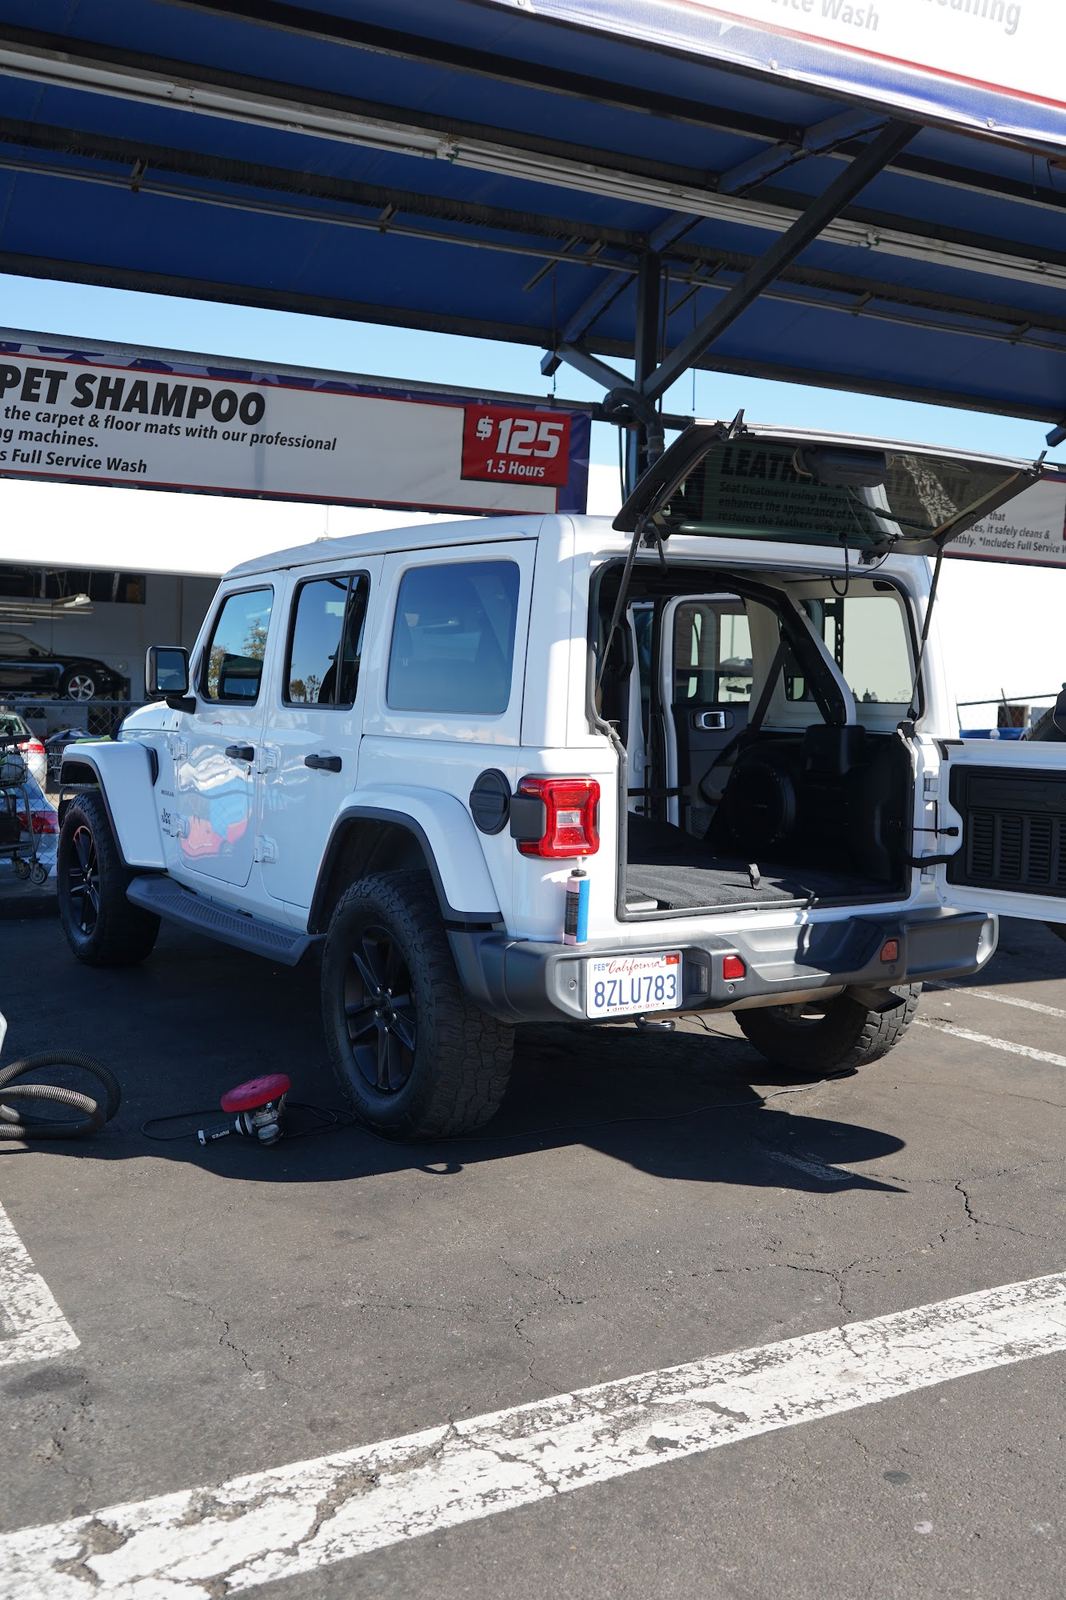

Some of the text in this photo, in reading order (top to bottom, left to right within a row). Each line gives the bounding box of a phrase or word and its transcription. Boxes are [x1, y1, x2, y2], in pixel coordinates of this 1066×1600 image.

[821, 0, 880, 31] Wash
[0, 363, 266, 426] PET SHAMPOO
[4, 405, 337, 451] the carpet & floor mats with our professional
[18, 428, 99, 448] machines.
[475, 416, 564, 459] $125
[11, 448, 42, 465] Full
[46, 451, 102, 470] Service
[106, 456, 148, 474] Wash
[486, 459, 546, 477] 1.5 Hours
[720, 446, 829, 487] LEATH
[989, 511, 1006, 522] that
[986, 523, 994, 533] it
[994, 525, 1018, 539] safely
[1019, 527, 1043, 539] cleans
[1043, 530, 1051, 540] &
[1017, 539, 1032, 551] Full
[1033, 542, 1061, 554] Service
[608, 957, 666, 977] California
[594, 973, 677, 1008] 8ZLU783
